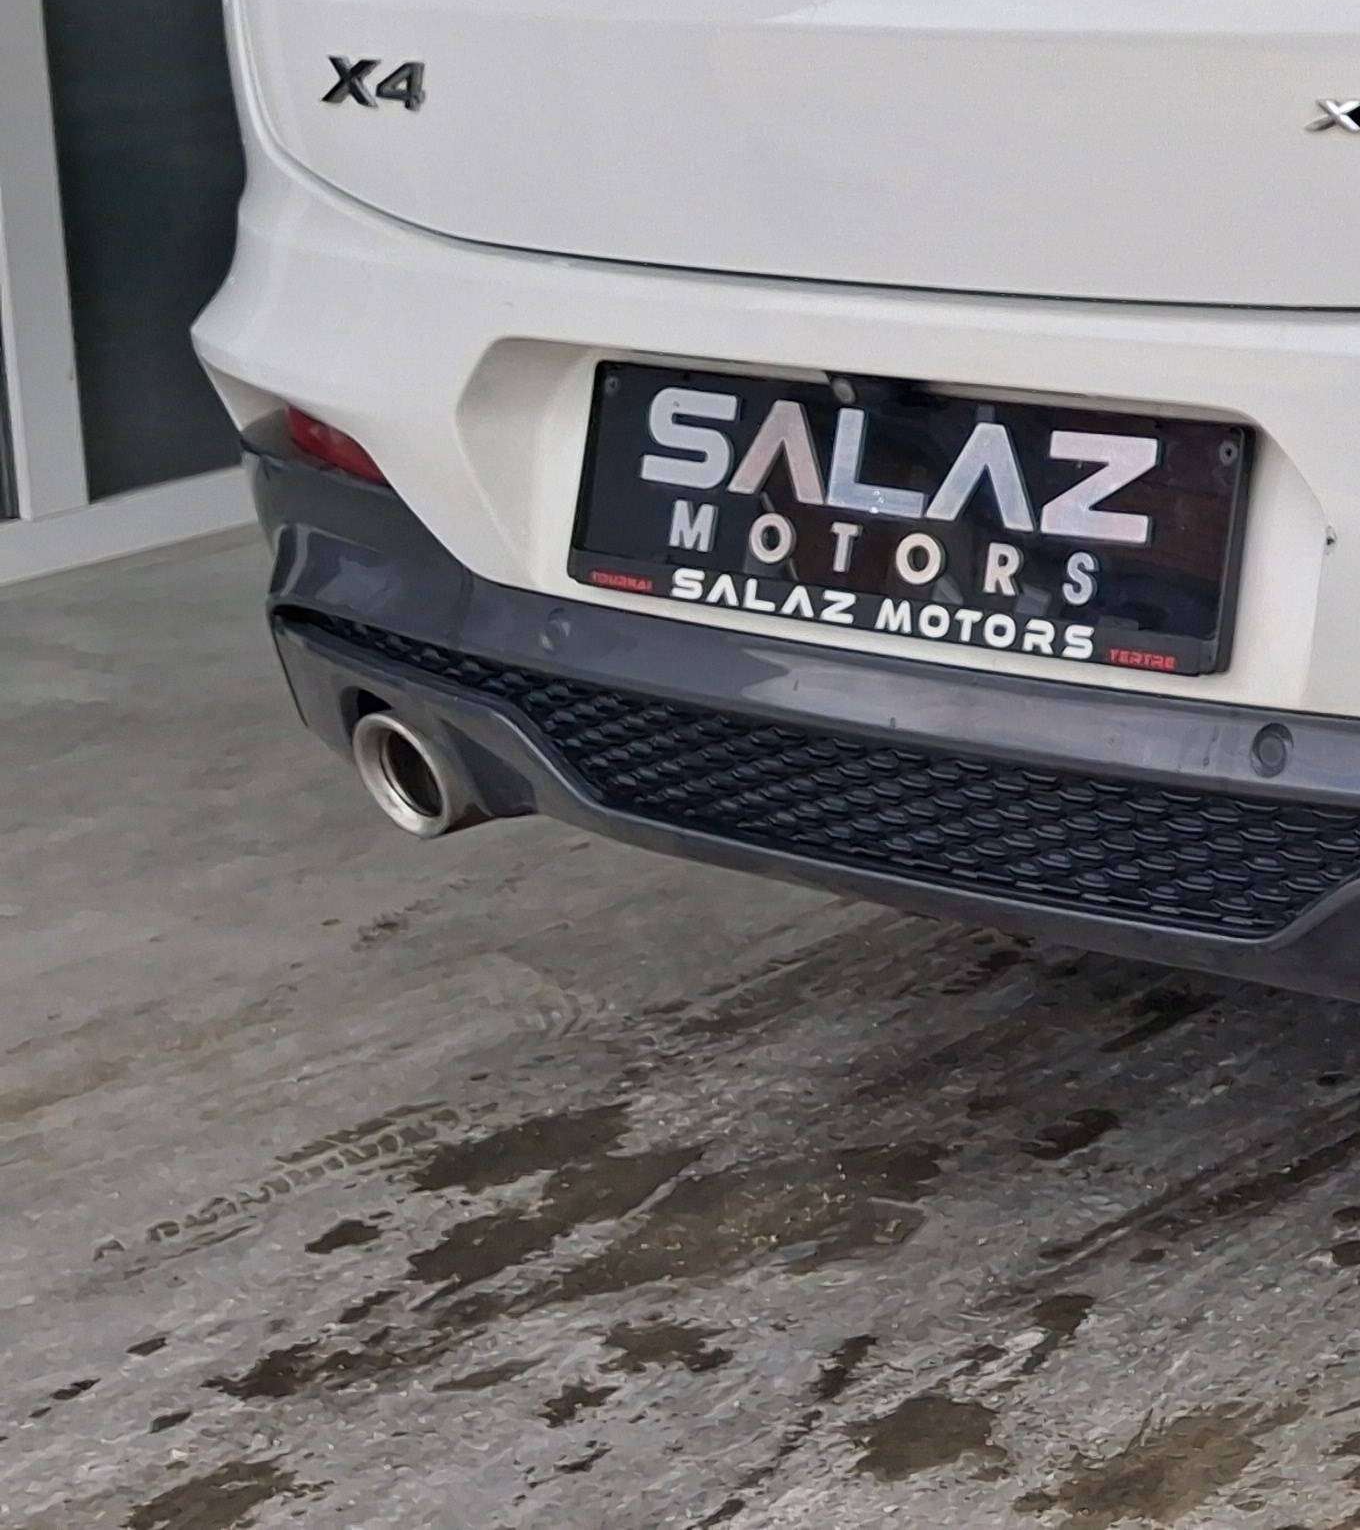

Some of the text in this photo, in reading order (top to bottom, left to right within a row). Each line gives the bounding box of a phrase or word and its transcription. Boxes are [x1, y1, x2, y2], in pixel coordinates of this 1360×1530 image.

[321, 55, 425, 111] X4
[641, 388, 1159, 544] SALAZ
[668, 501, 1099, 607] MOTORS
[671, 568, 1096, 660] SALAZ MOTORS
